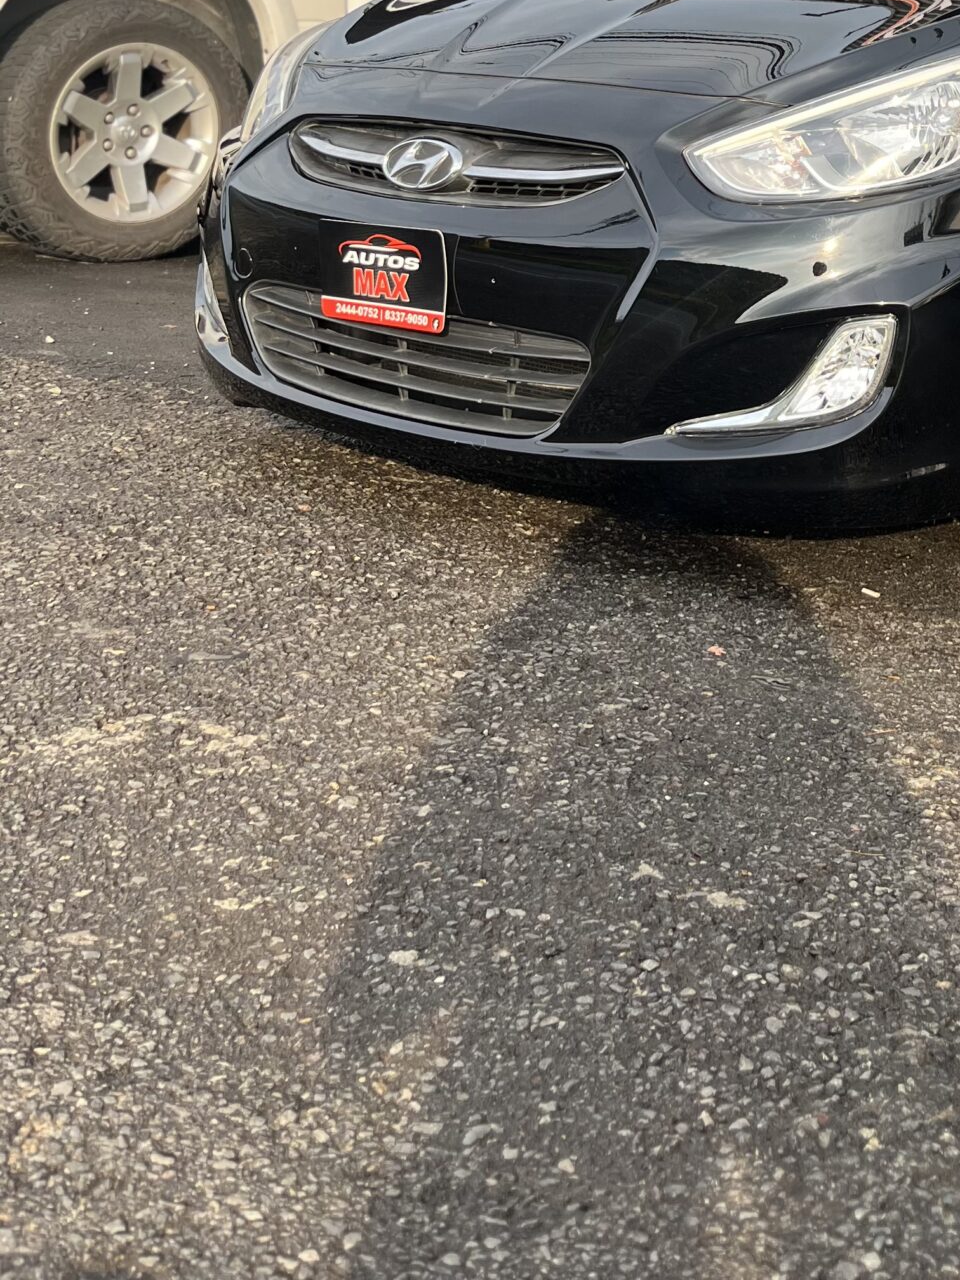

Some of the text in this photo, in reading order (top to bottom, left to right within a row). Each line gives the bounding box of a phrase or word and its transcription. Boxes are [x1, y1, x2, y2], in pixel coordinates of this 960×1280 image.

[342, 250, 420, 271] AUTOS
[353, 267, 410, 302] MAX
[335, 302, 379, 319] 2444-0752
